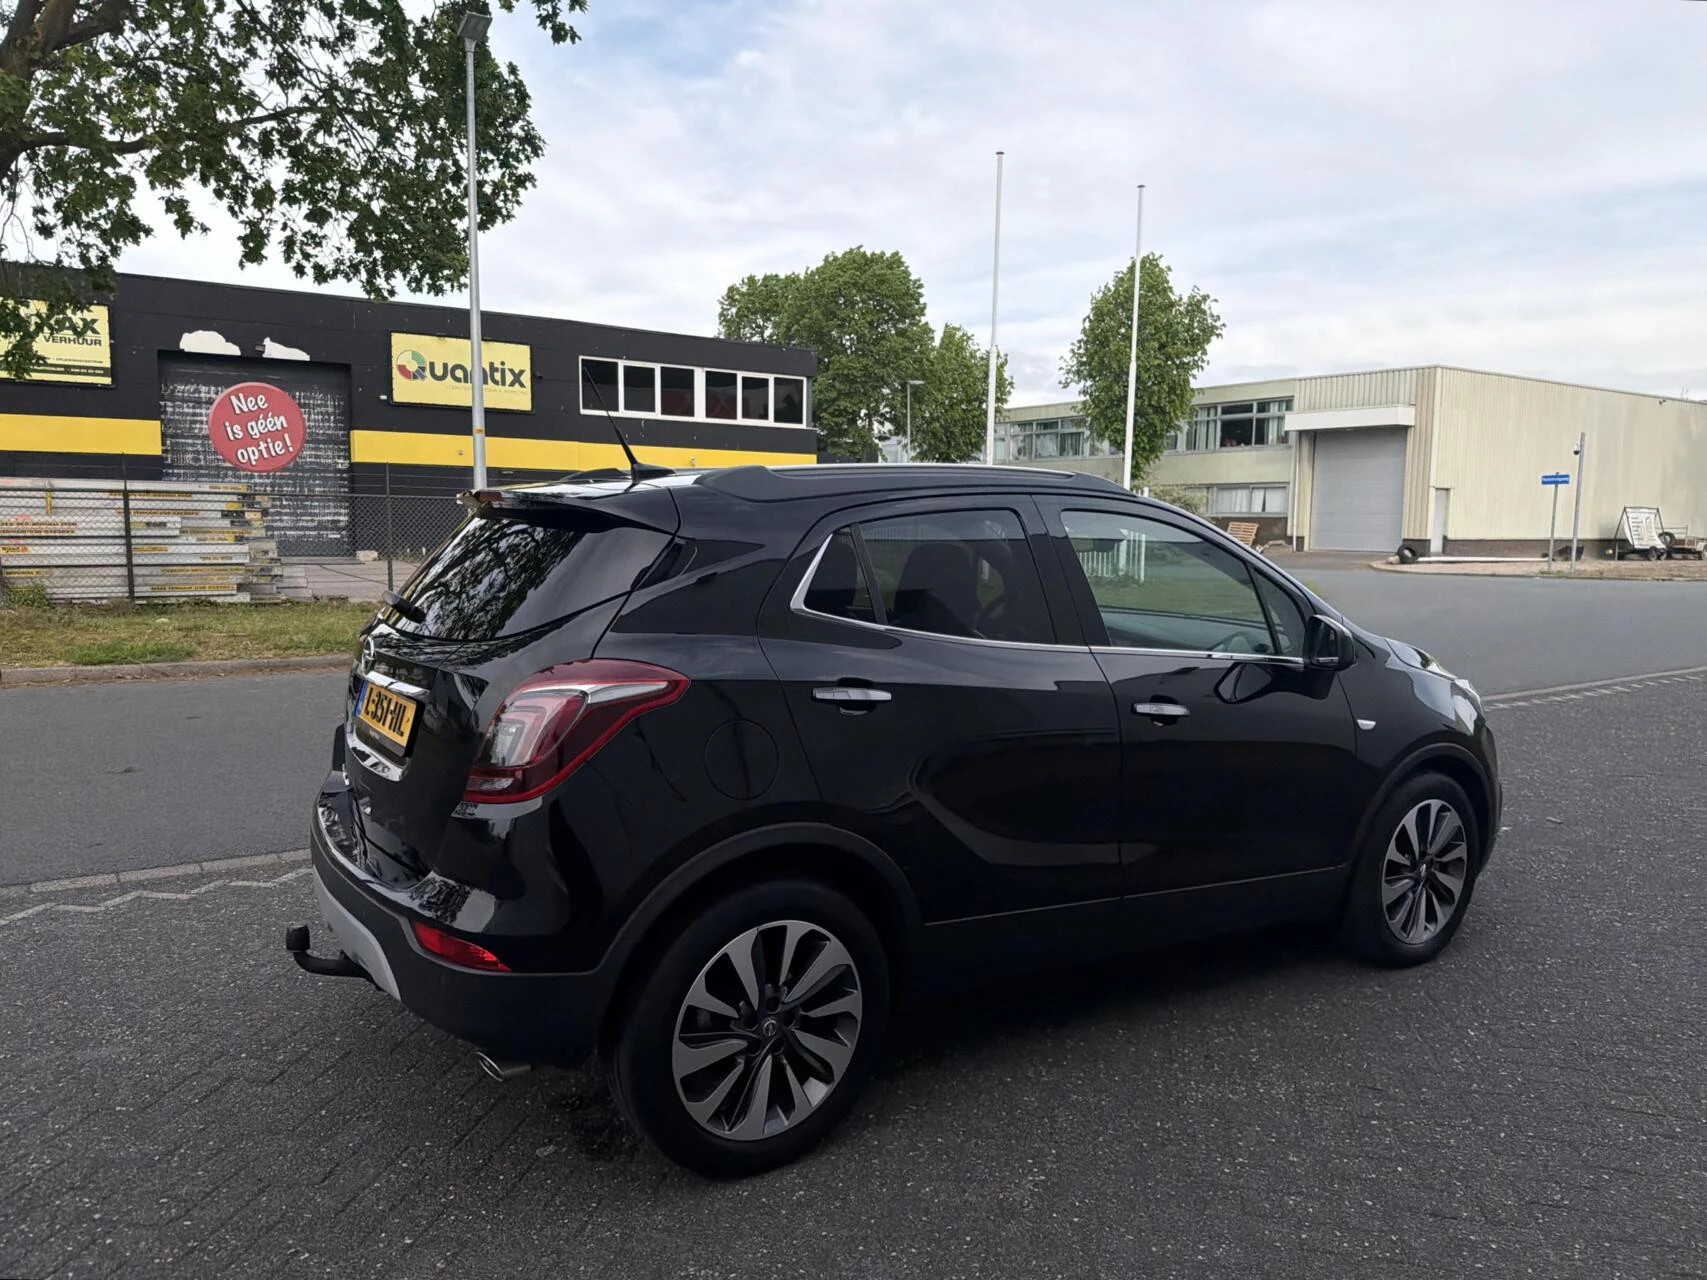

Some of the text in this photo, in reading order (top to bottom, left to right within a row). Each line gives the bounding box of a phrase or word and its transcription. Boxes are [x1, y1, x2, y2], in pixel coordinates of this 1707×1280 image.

[43, 334, 102, 346] VERHUUR
[230, 392, 268, 415] Nee
[224, 411, 288, 441] is géén
